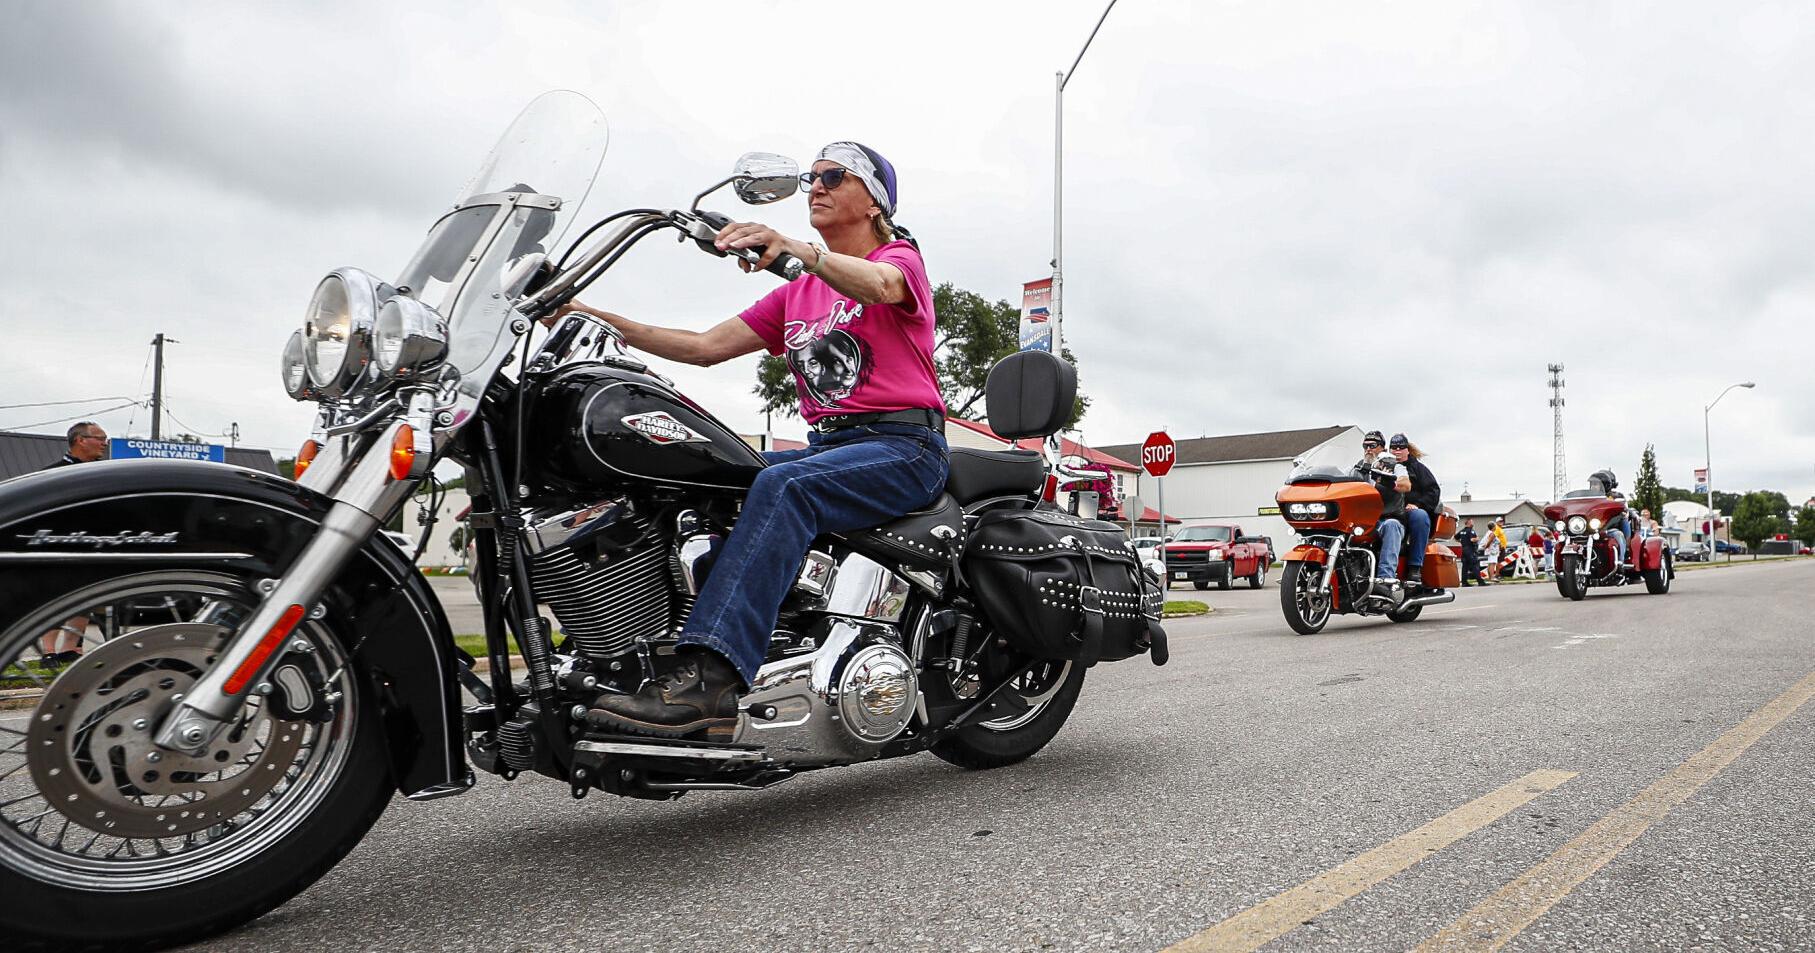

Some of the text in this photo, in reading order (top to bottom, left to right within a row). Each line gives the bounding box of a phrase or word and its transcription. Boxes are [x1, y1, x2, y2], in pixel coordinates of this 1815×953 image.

[1024, 286, 1051, 296] Welcome
[1020, 328, 1050, 349] EVANSDALE
[636, 422, 688, 441] DAVIDSON
[127, 440, 210, 453] COUNTRYSIDE
[140, 448, 199, 459] VINEYARD
[1144, 444, 1173, 464] STOP
